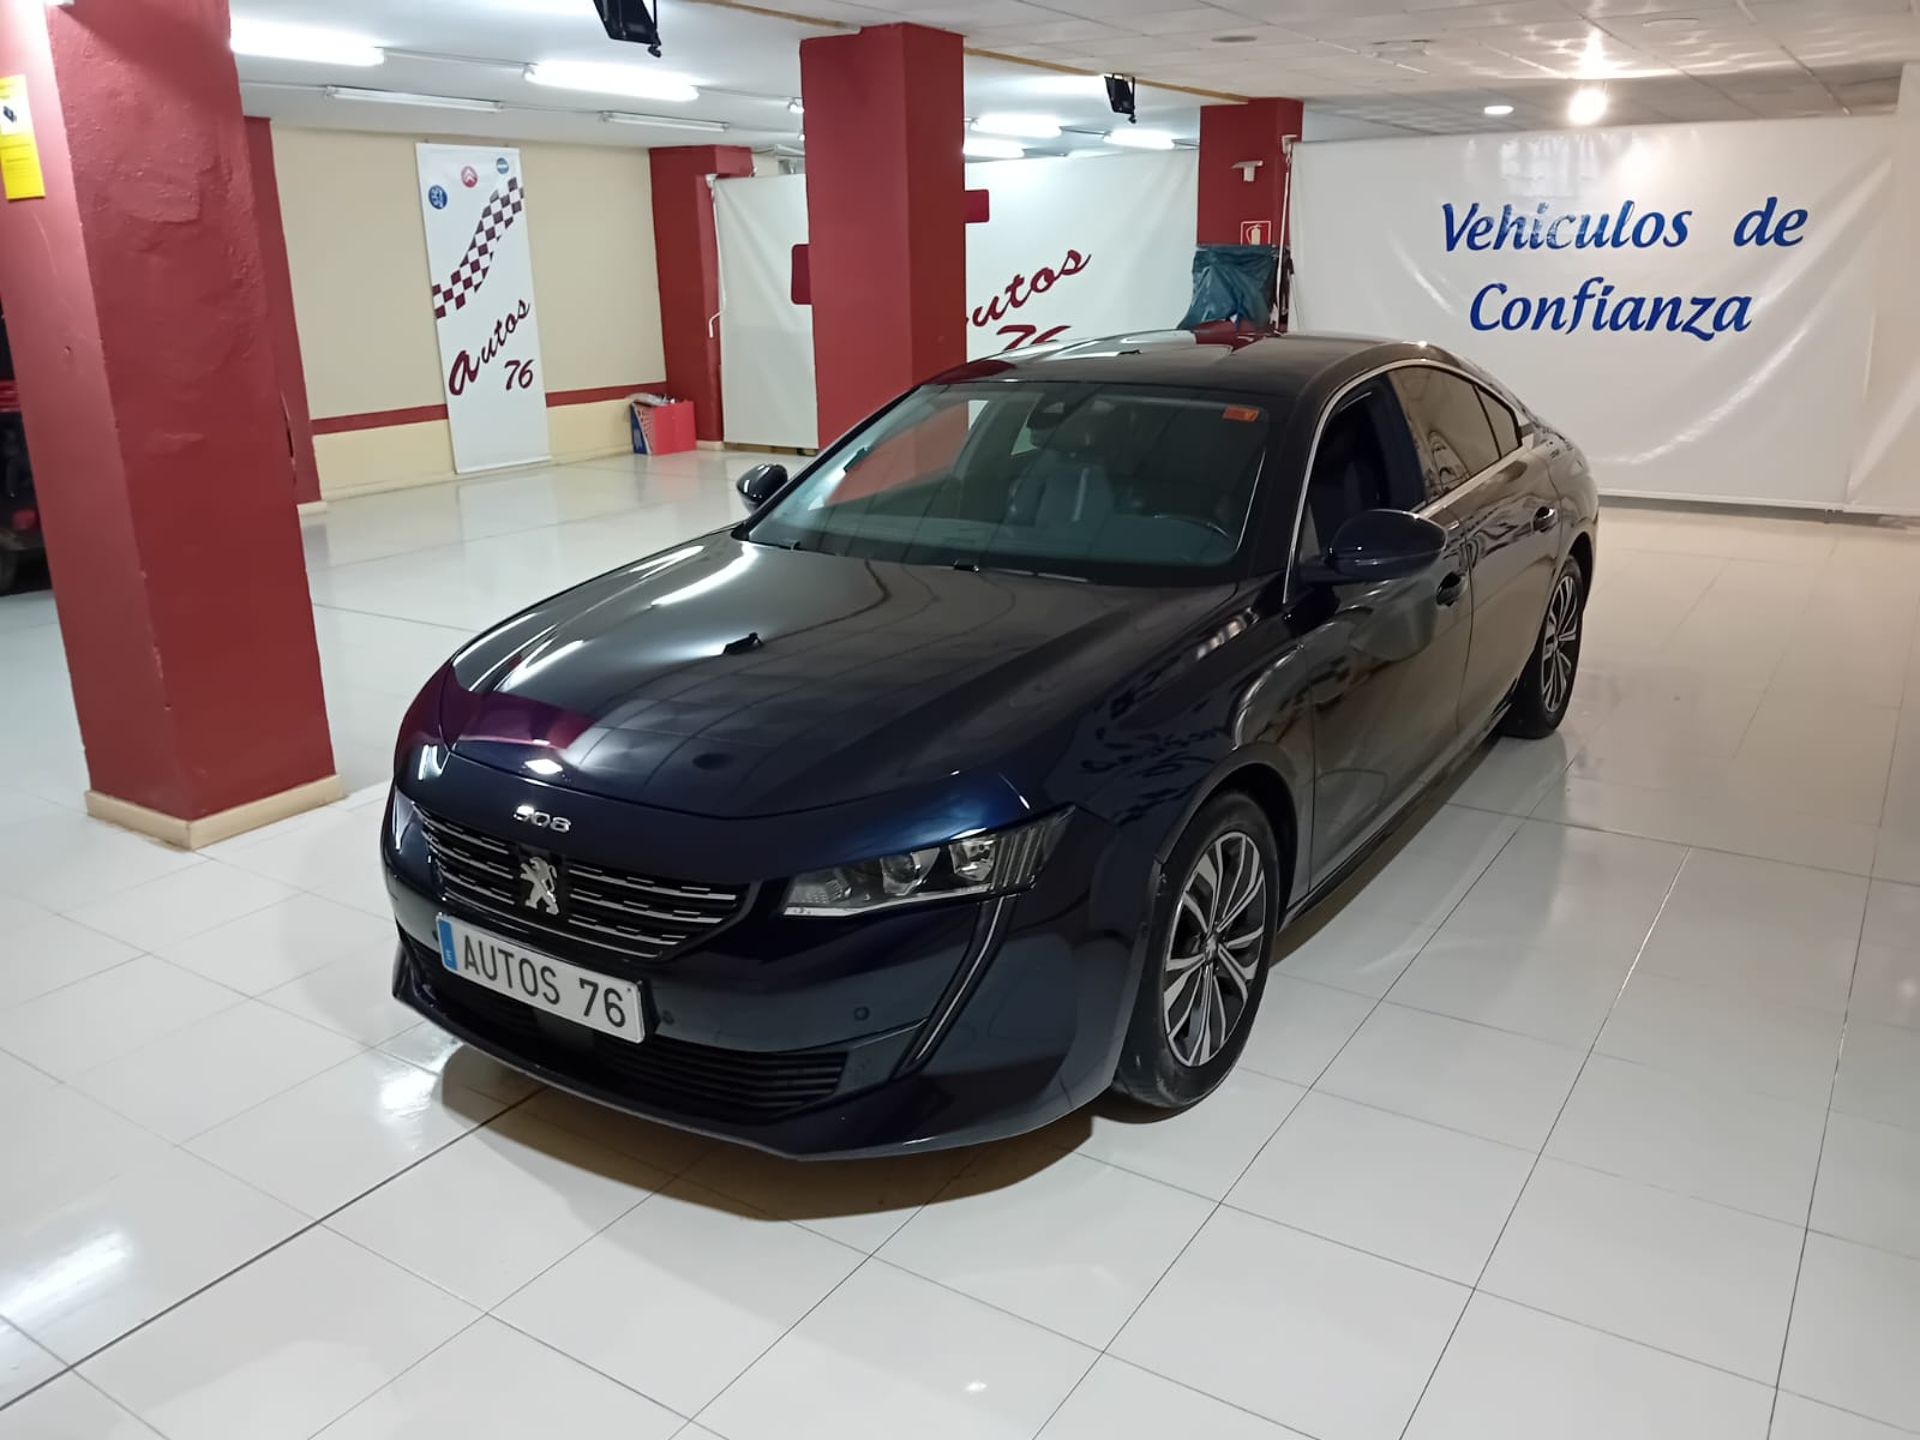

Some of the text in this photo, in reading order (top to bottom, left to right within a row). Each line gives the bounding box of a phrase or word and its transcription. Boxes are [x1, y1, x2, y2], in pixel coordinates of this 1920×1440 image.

[1442, 196, 1808, 251] Vehiculos de
[966, 249, 1092, 327] utos
[1470, 276, 1754, 342] Confianza
[504, 358, 535, 391] 76
[464, 935, 626, 1028] AUTOS 76
